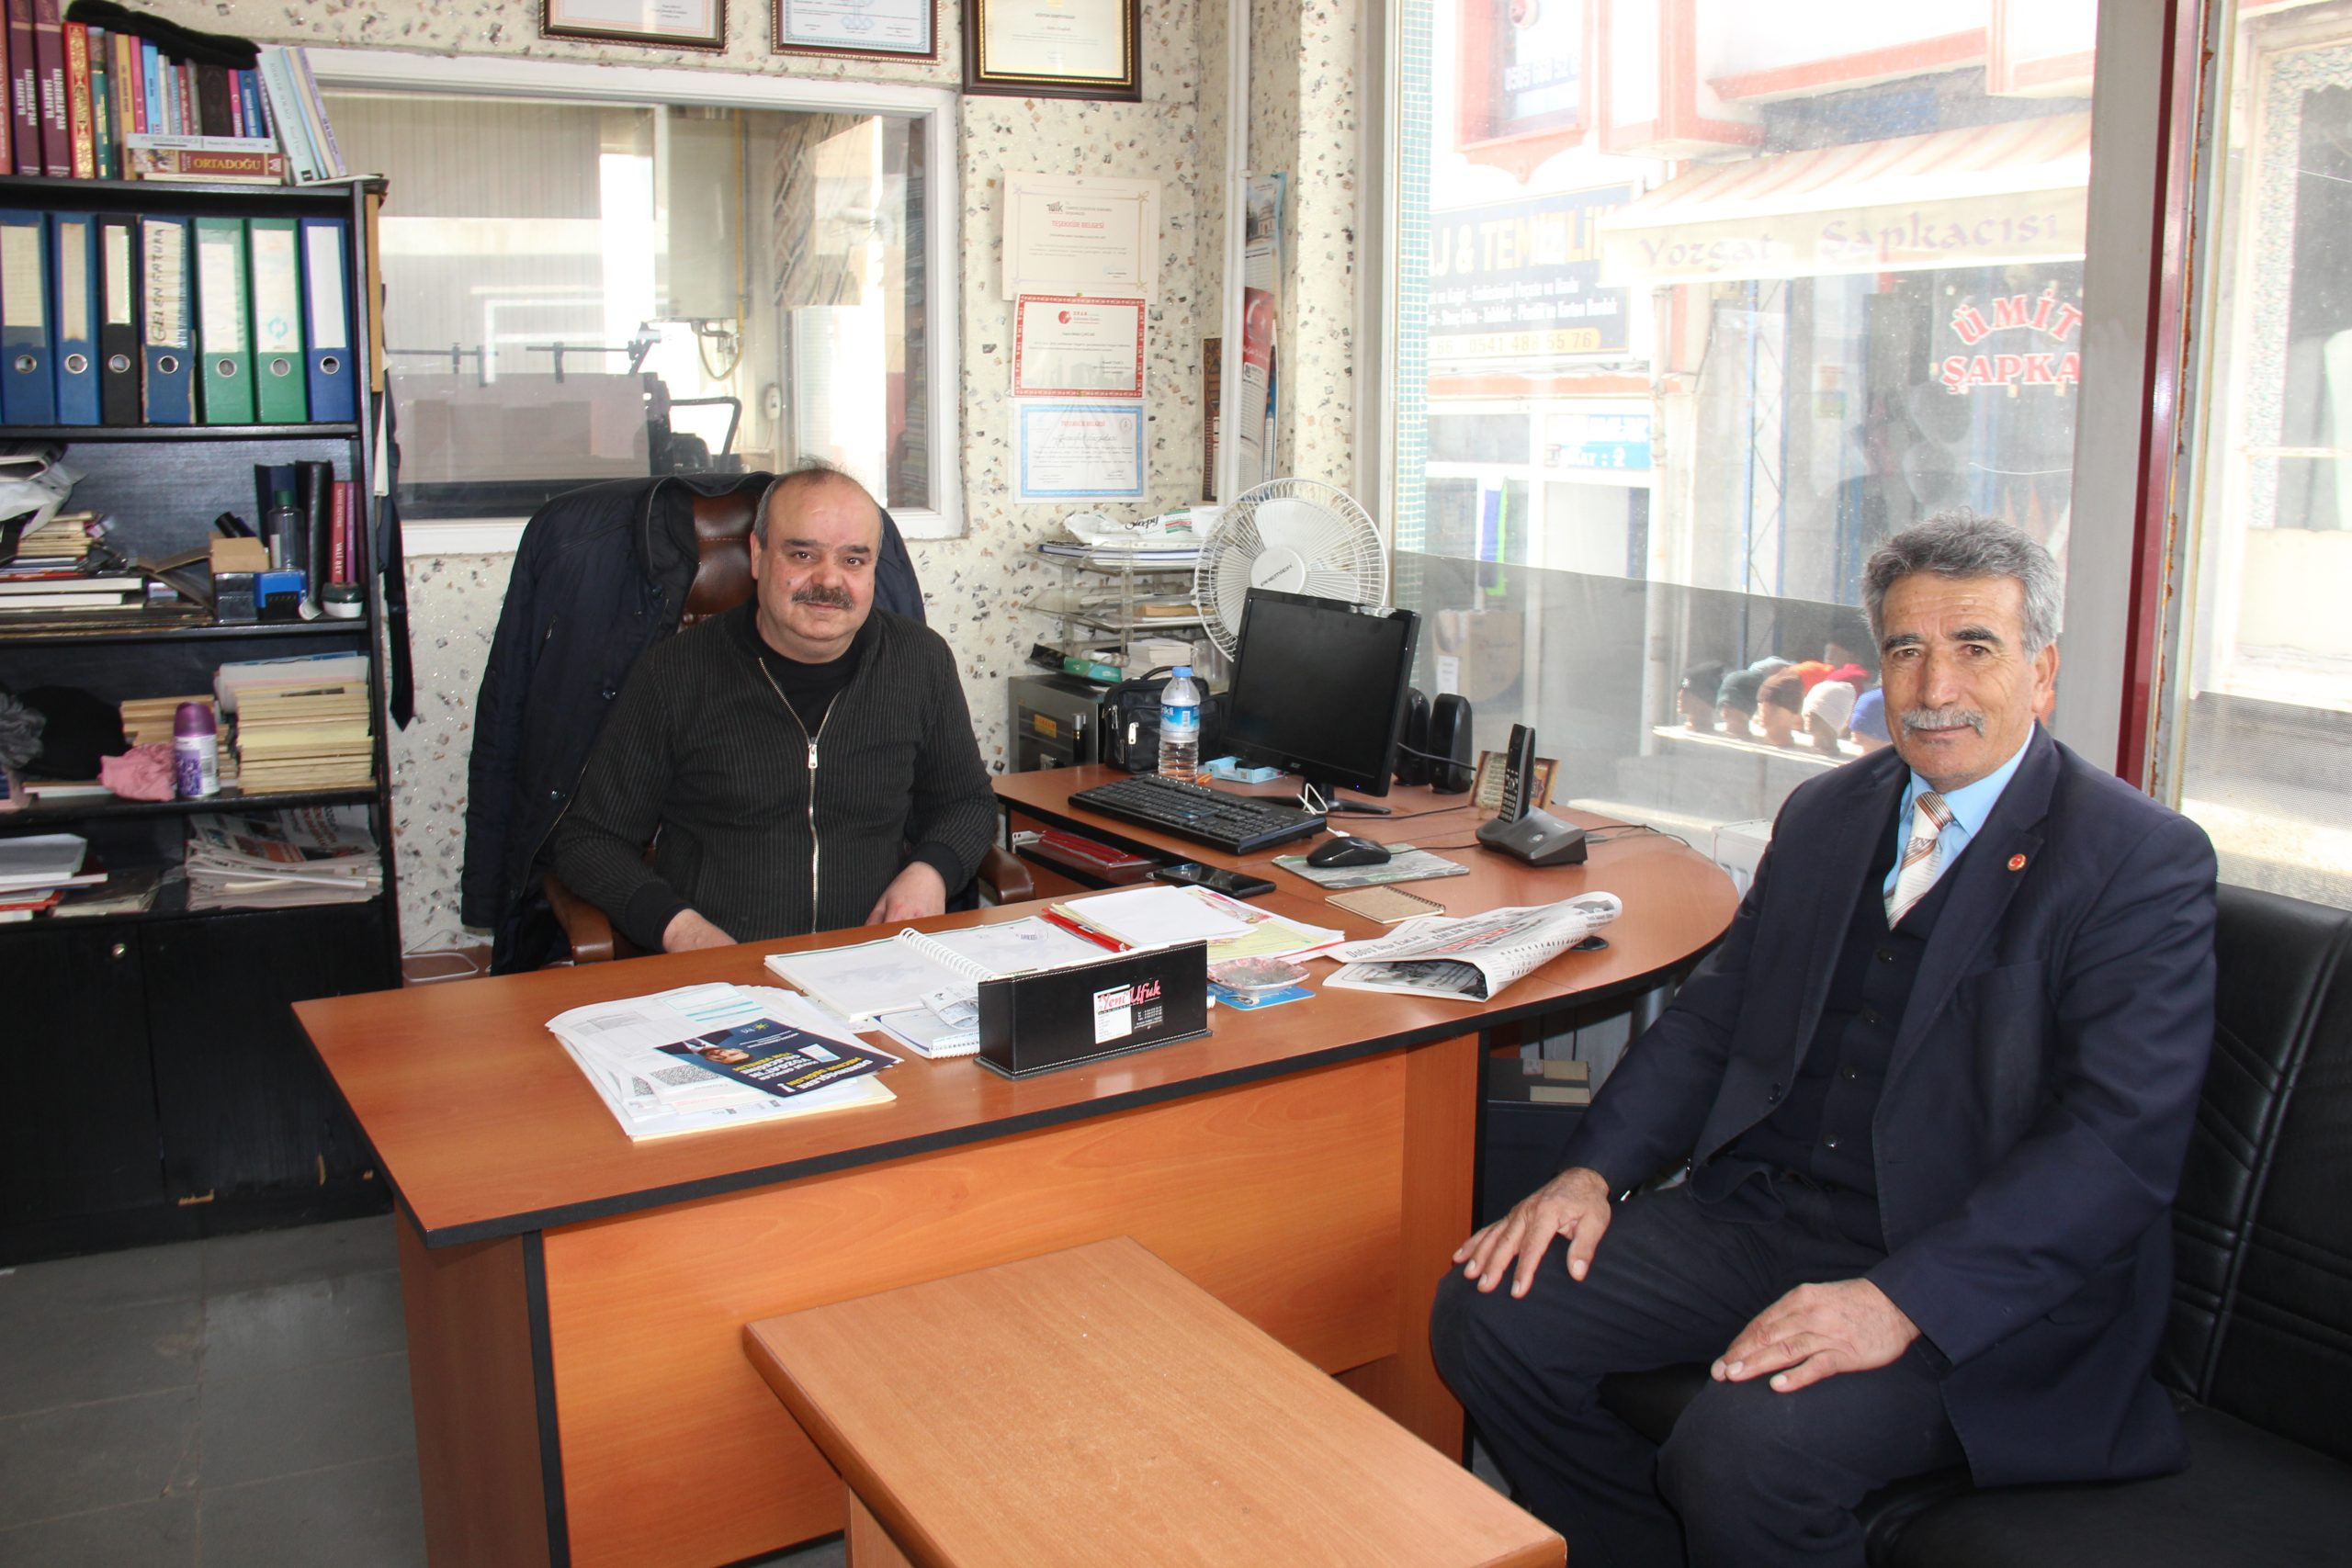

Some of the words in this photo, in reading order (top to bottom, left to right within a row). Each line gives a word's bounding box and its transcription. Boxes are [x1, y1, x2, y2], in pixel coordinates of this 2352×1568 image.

[194, 155, 261, 171] ORTADOĞU
[152, 228, 166, 281] FATURA
[1478, 204, 1617, 272] TEMLİK
[1639, 233, 1774, 274] Yozgat
[147, 287, 165, 343] GELEN
[1950, 288, 2083, 345] ÜMİT
[1572, 332, 1592, 348] 76
[1939, 352, 2080, 394] ŞAPKA
[1099, 992, 1129, 1011] Yeni
[1129, 980, 1161, 1005] Ufuk
